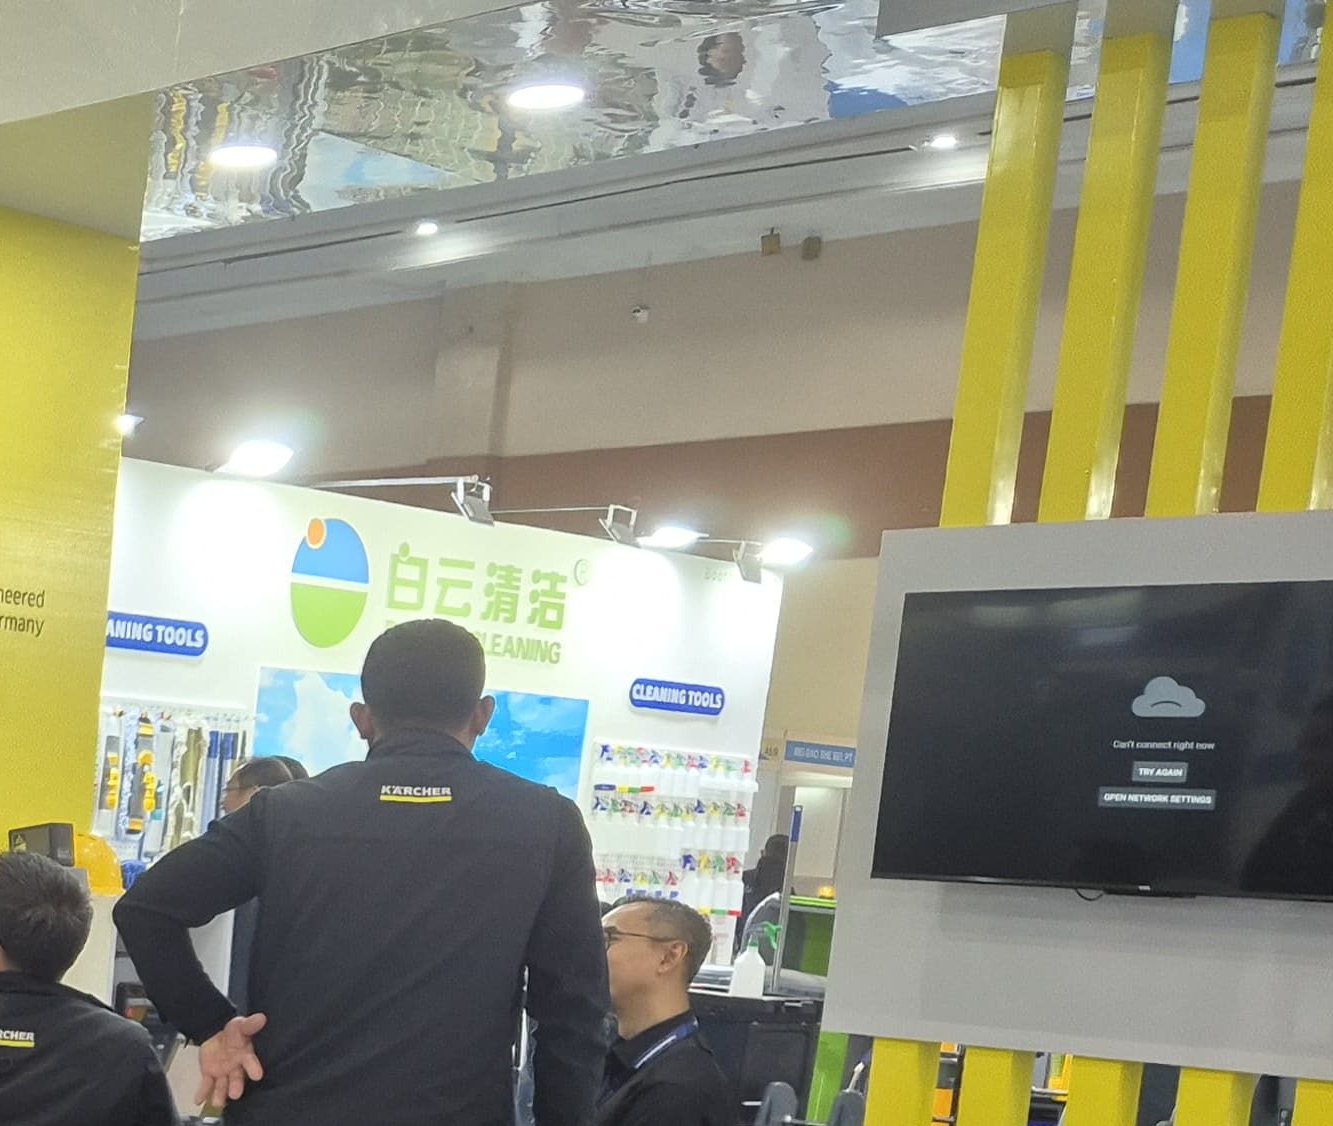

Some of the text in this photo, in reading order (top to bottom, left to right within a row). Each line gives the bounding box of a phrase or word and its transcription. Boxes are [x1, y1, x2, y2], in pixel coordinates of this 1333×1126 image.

[387, 542, 567, 630] 白云清洁
[106, 618, 205, 648] ANING TOOLS
[632, 683, 723, 708] CLEANING TOOLS
[1136, 741, 1172, 749] connect
[1173, 741, 1194, 751] right
[1195, 742, 1215, 750] now
[1139, 767, 1183, 777] TRY AGAIN
[1104, 793, 1212, 804] OPEN NETWORK SETTINGS
